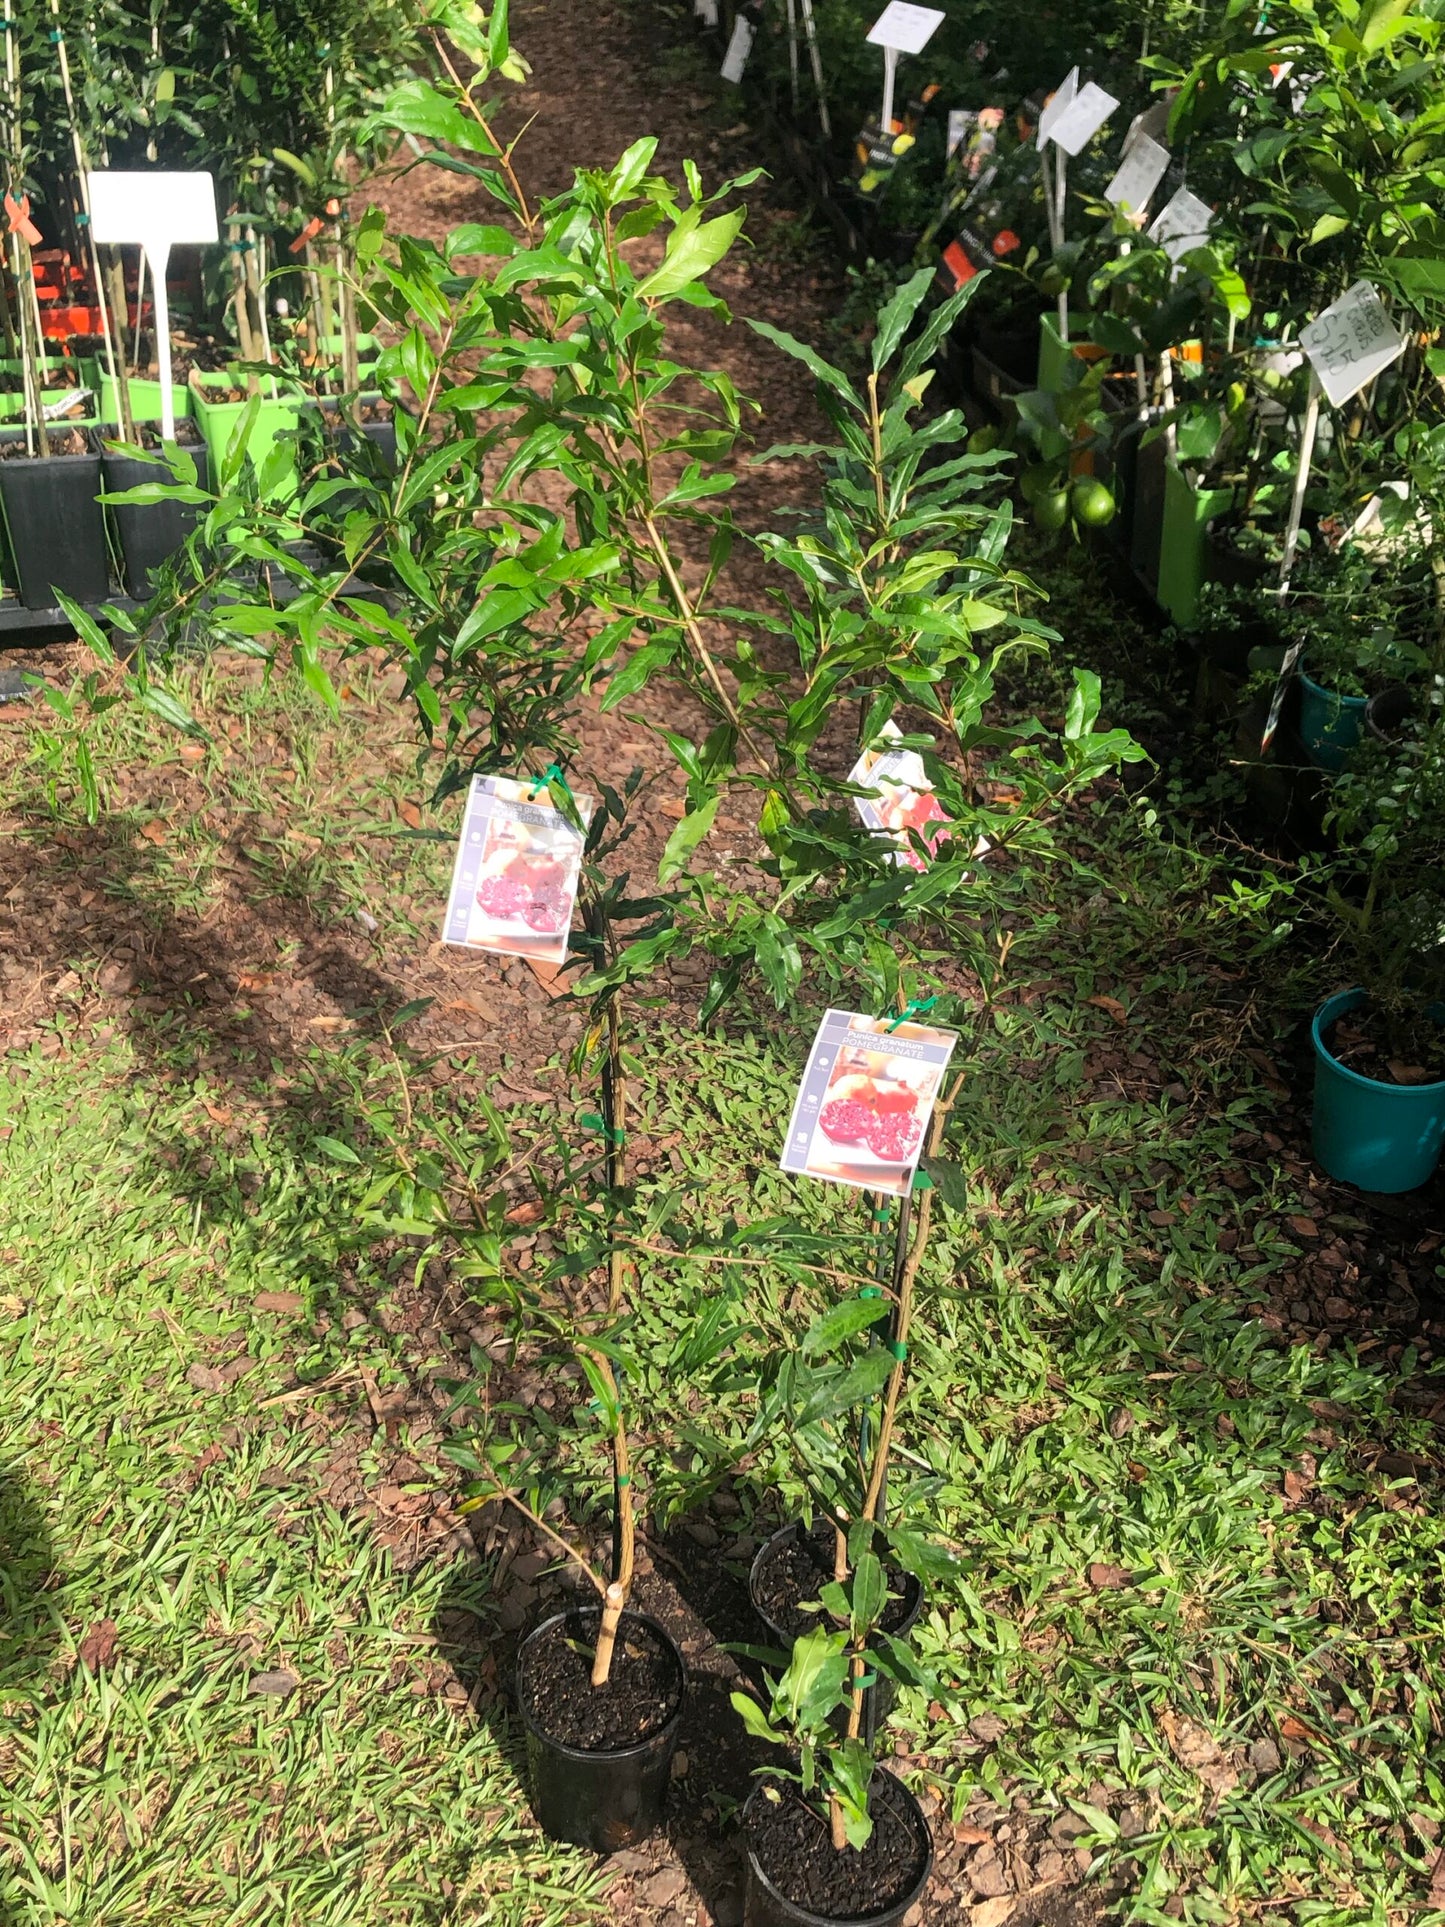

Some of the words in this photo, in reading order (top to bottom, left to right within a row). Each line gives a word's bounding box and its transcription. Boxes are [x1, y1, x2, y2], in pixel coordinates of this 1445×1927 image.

[491, 806, 566, 829] OMEGRANTE
[841, 1036, 925, 1059] POMEGRANATE
[847, 1030, 878, 1043] Punica
[879, 1037, 924, 1051] granatum
